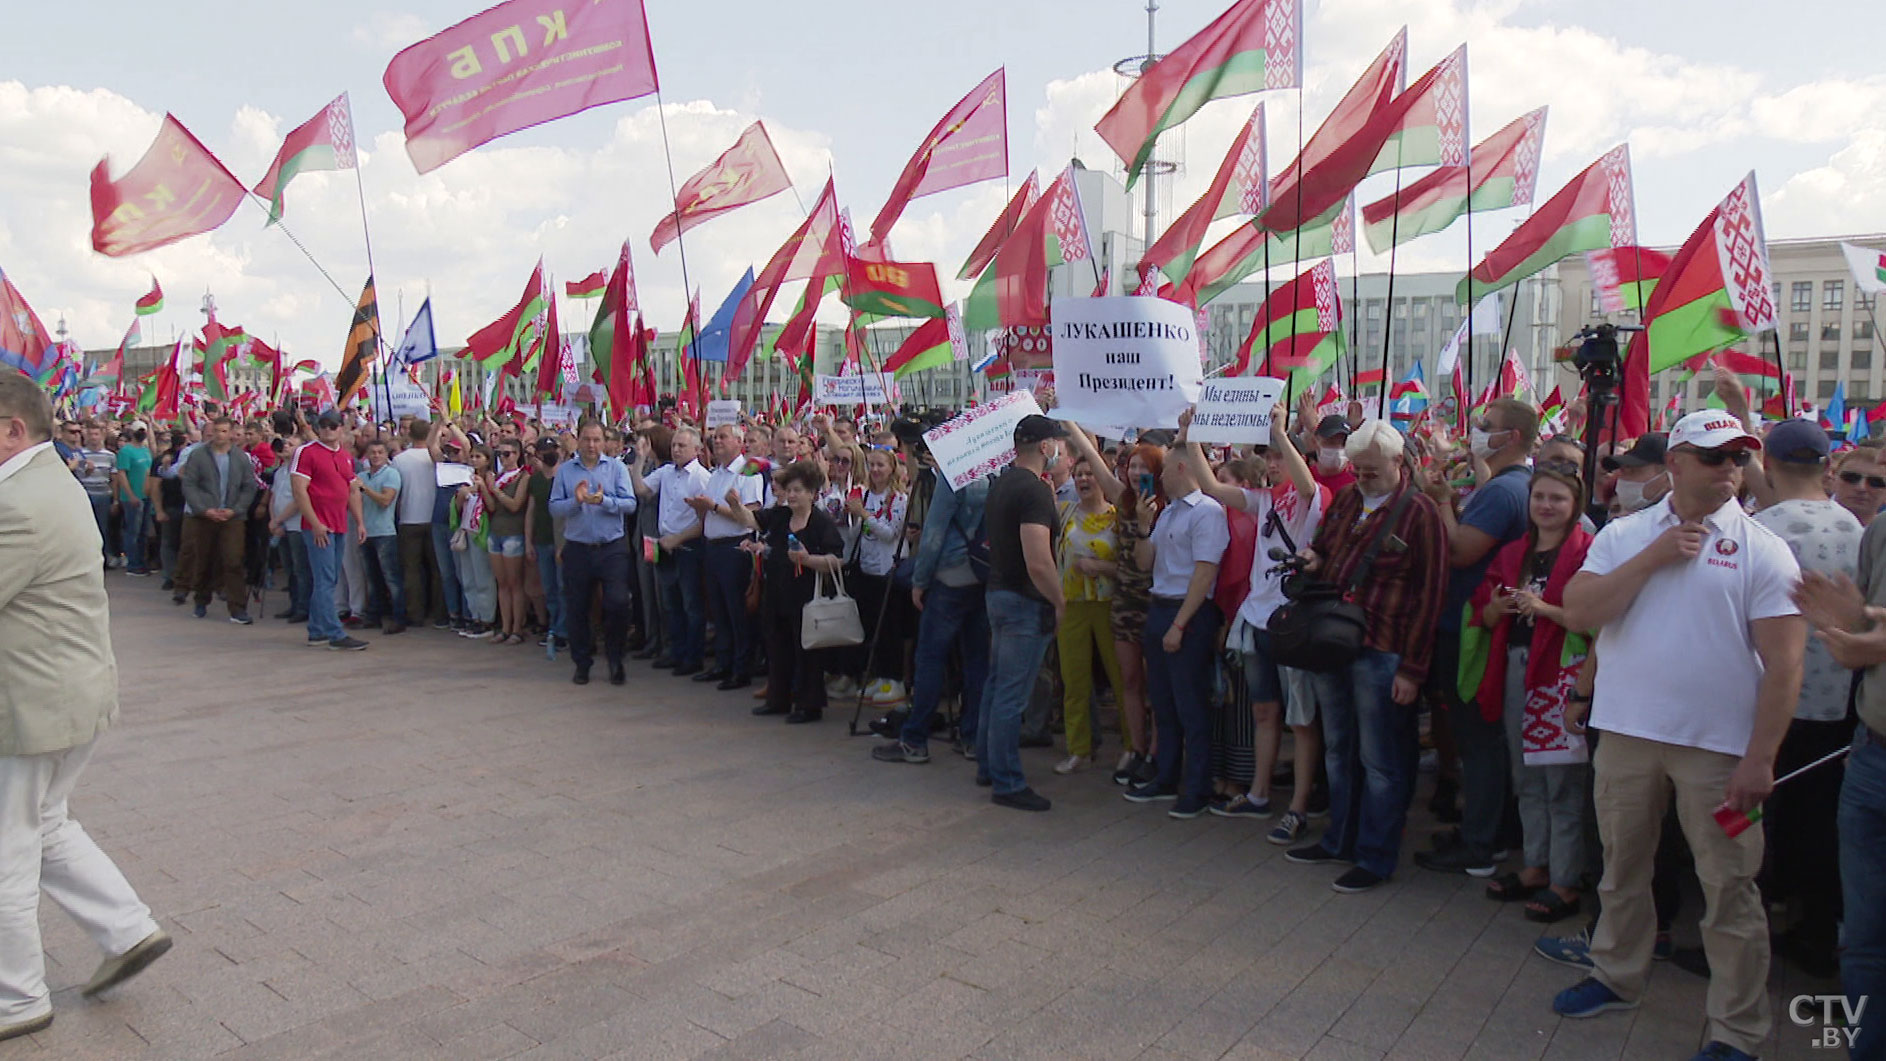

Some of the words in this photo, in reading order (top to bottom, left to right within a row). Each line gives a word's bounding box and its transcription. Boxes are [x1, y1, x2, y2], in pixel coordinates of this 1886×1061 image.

[1061, 321, 1190, 342] ЛУКАШЕНКО
[1106, 352, 1140, 364] наш
[1079, 373, 1174, 392] Президент!
[1203, 385, 1222, 402] Мы
[1223, 389, 1260, 403] едины
[1193, 413, 1210, 426] мы
[1707, 558, 1738, 570] BELARUS
